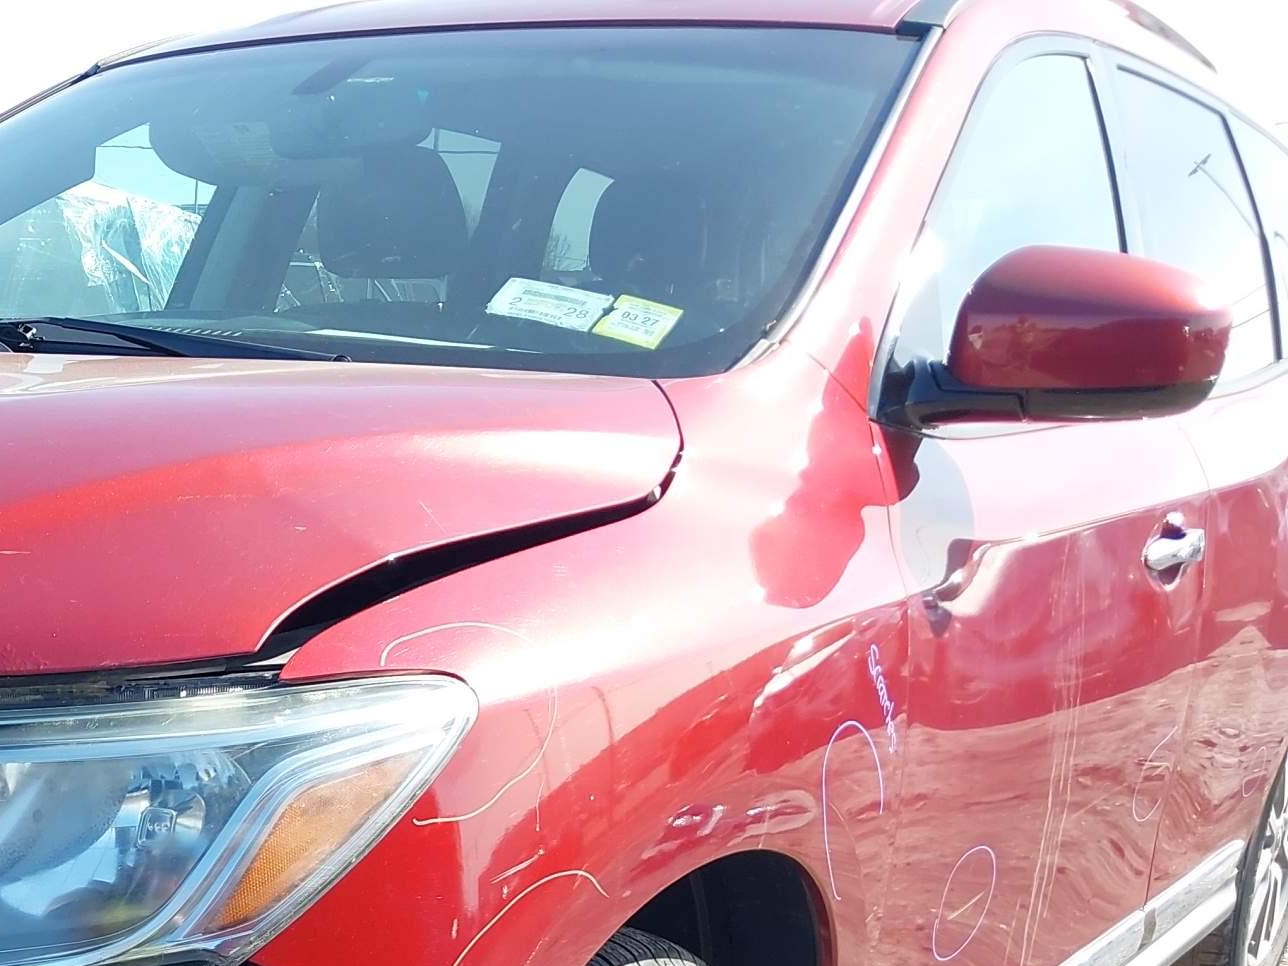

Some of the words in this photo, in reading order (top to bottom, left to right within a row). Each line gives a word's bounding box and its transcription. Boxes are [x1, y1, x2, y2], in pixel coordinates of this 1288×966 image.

[509, 296, 523, 306] 2
[563, 307, 588, 319] 28
[643, 316, 660, 327] 27
